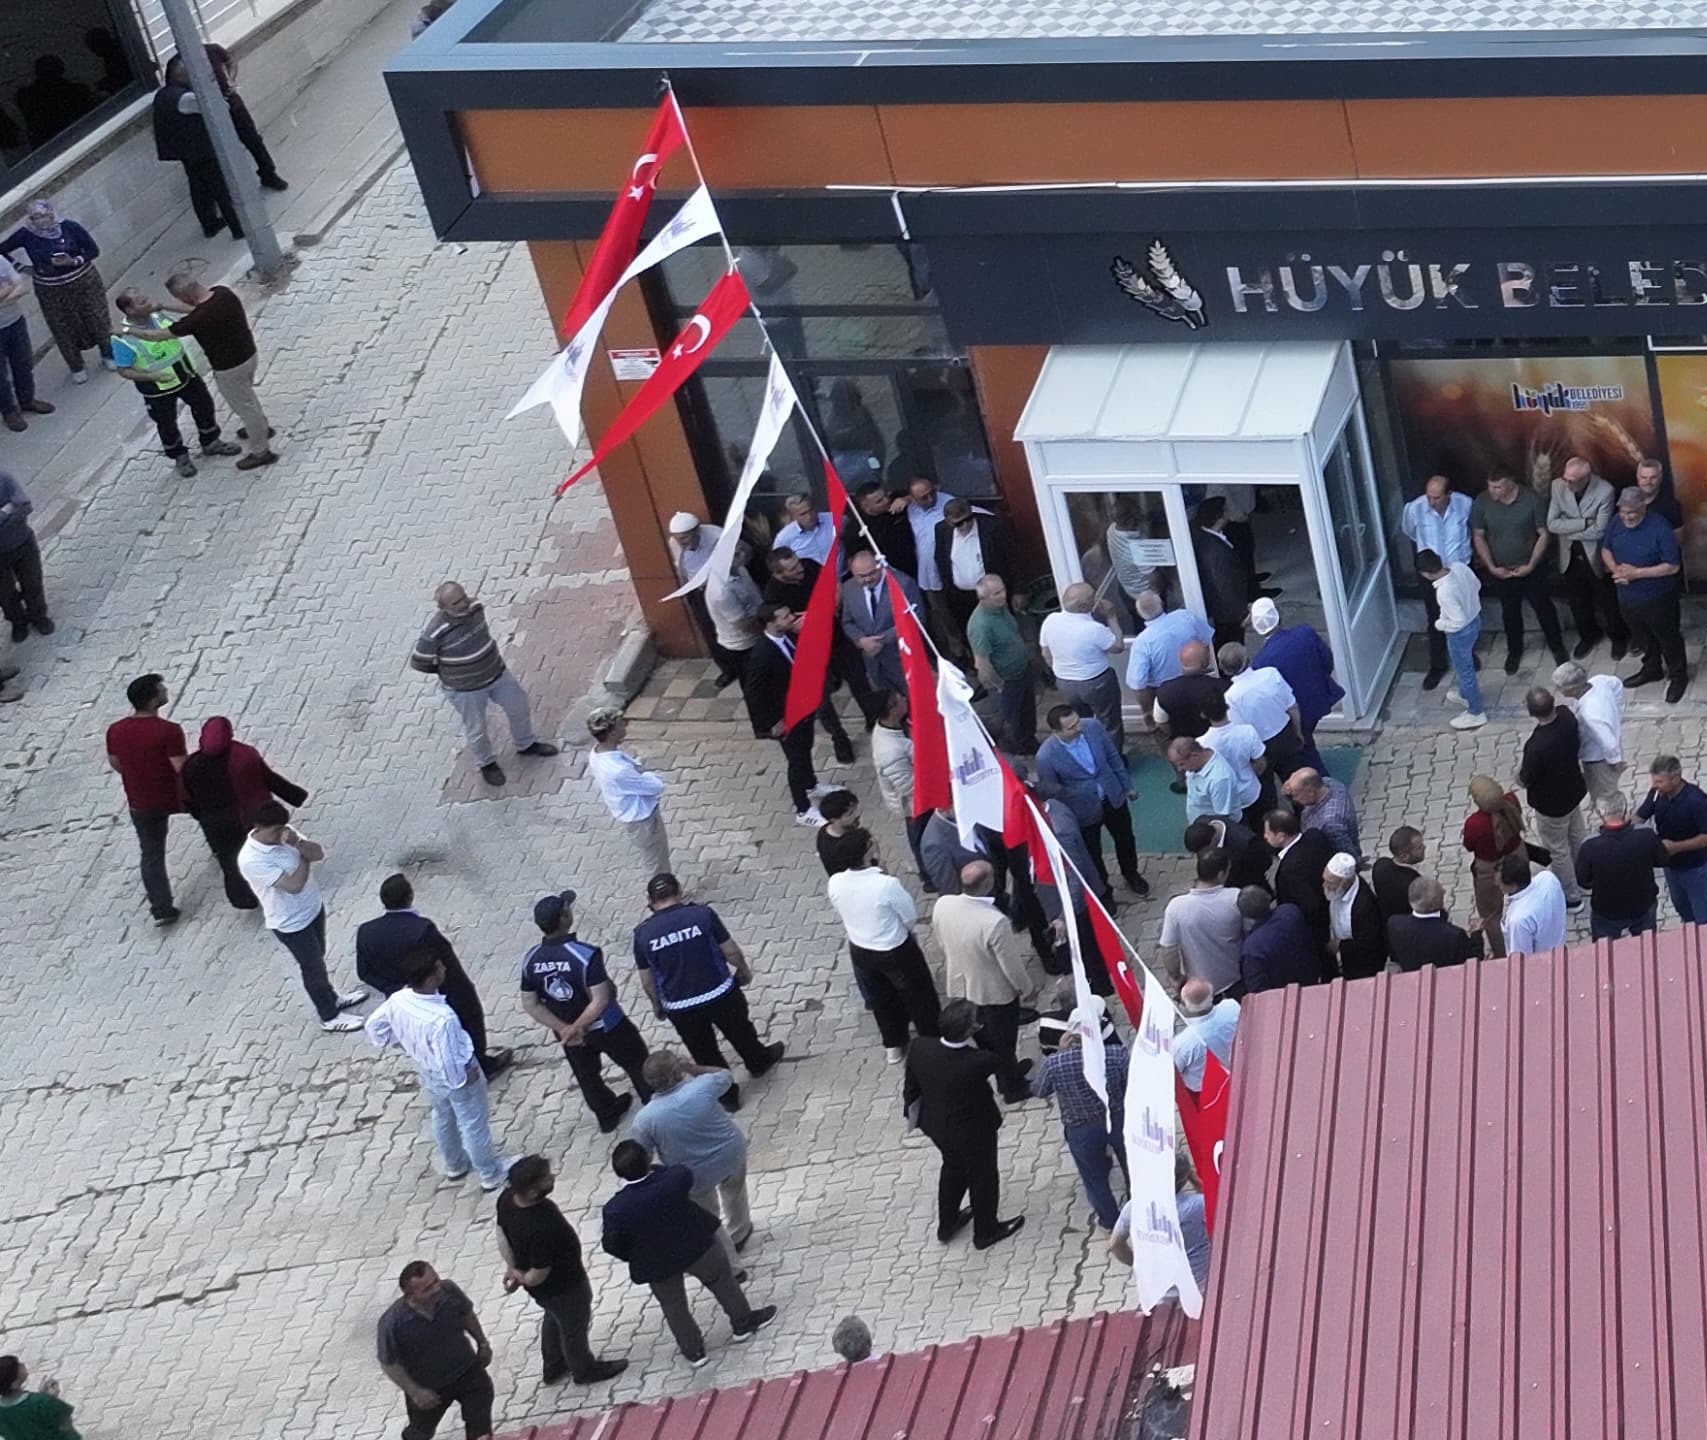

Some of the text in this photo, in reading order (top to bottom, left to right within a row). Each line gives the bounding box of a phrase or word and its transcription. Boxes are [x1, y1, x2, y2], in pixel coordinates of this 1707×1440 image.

[1226, 249, 1480, 312] HÜYÜK
[649, 924, 703, 952] ZABITA
[533, 961, 572, 974] ZABTA
